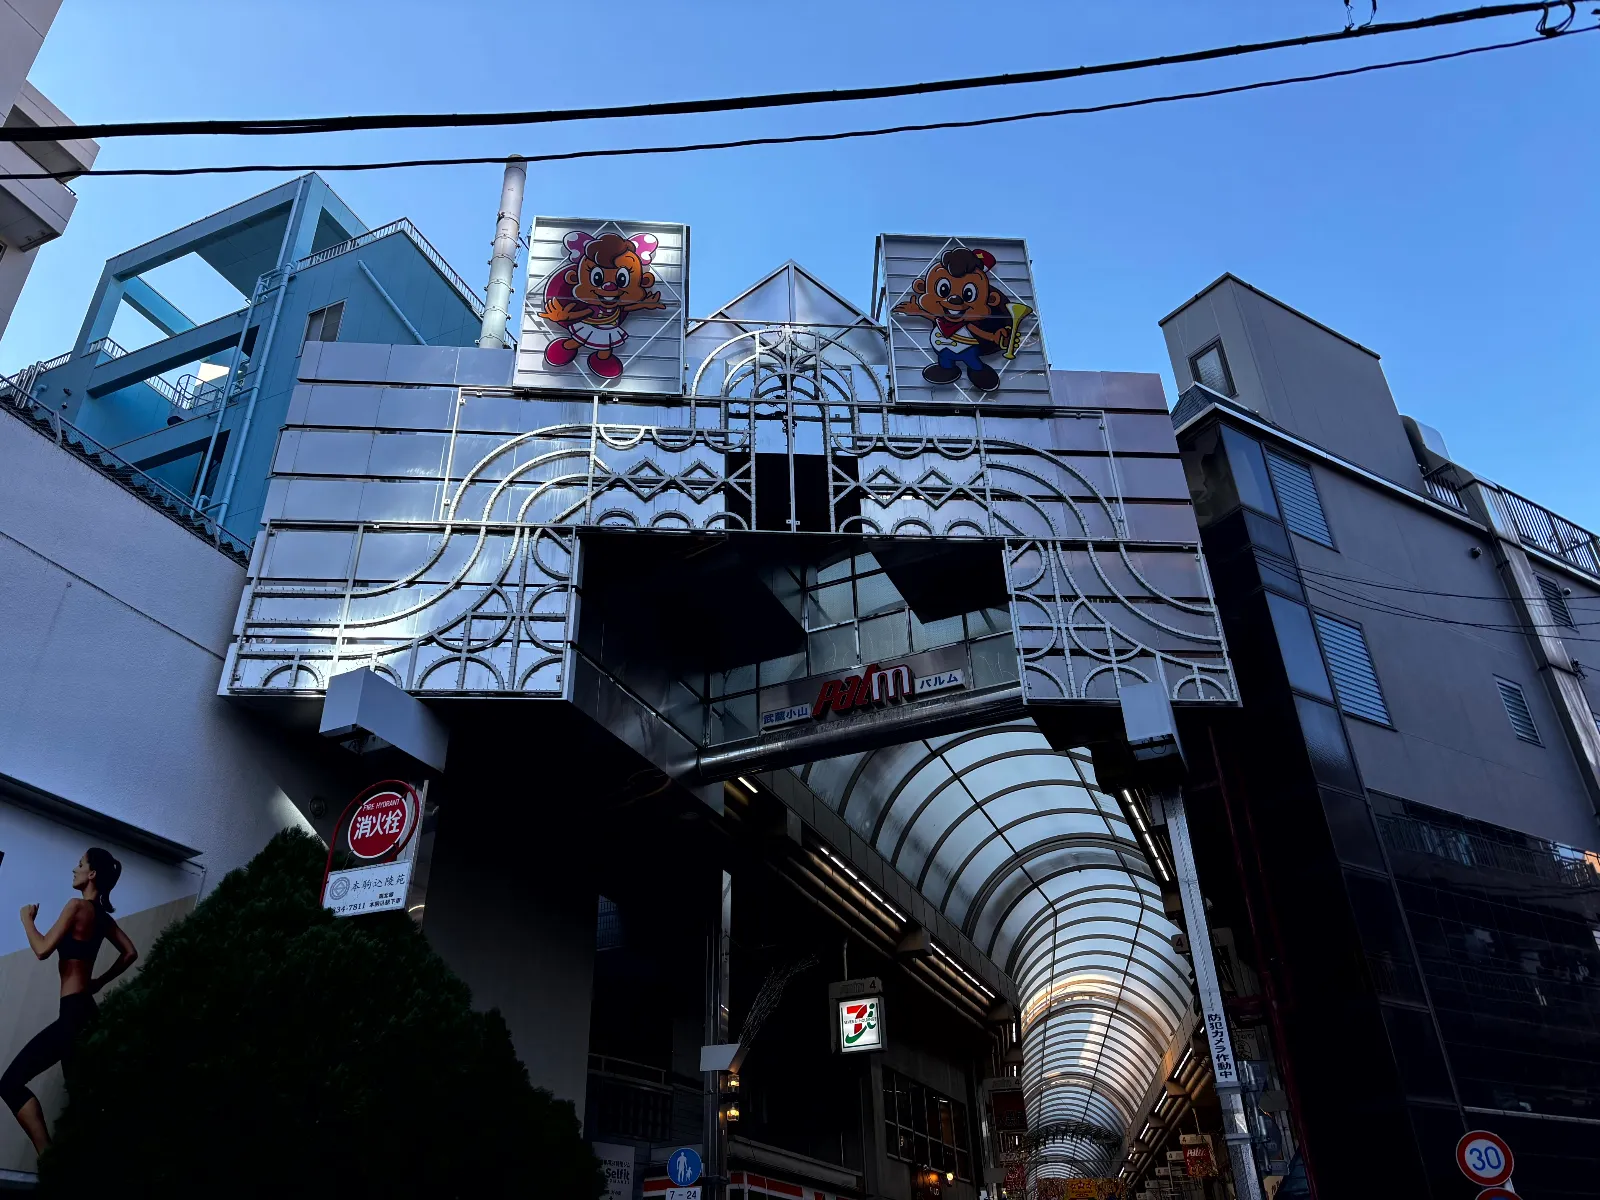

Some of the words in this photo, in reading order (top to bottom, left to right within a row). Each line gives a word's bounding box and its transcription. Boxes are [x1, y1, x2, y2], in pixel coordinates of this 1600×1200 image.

[763, 708, 808, 725] 武蔵小山
[362, 803, 375, 812] FIRE
[375, 798, 400, 810] HYDRANT
[353, 808, 403, 841] 消火栓
[1207, 1013, 1233, 1079] 防犯カメラ作動中
[1469, 1146, 1502, 1171] 30
[604, 1167, 630, 1181] Selfit
